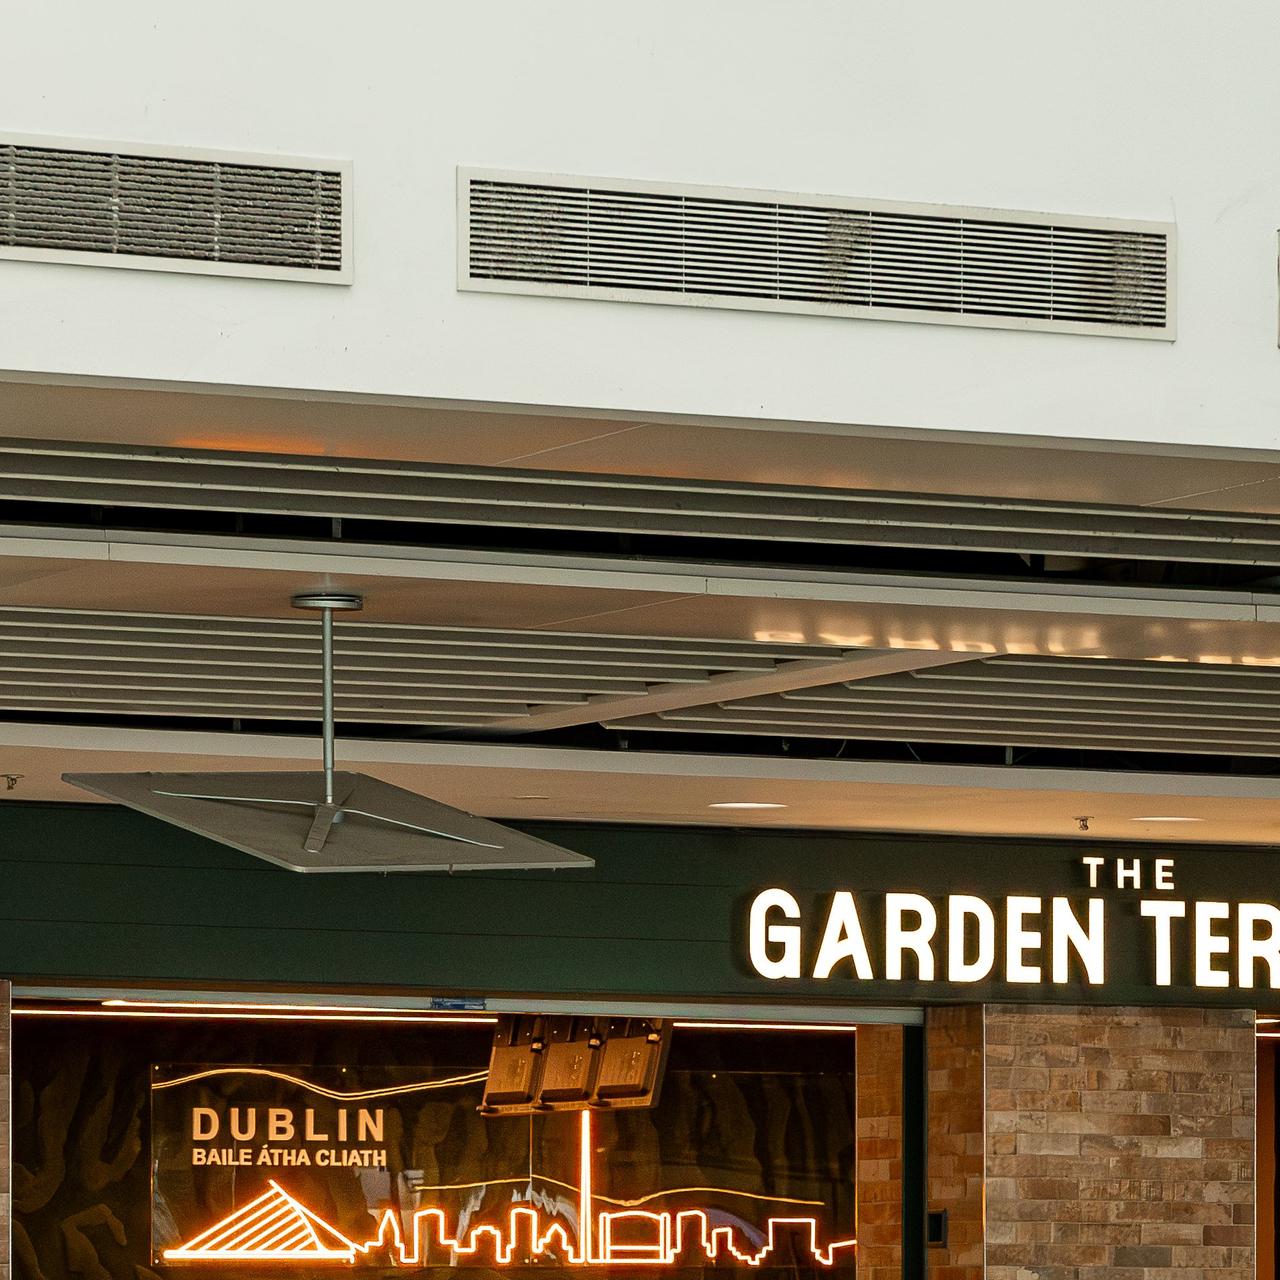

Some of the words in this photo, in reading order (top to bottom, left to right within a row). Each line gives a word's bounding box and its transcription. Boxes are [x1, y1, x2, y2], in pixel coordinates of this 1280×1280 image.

[1083, 857, 1175, 890] THE
[748, 887, 1105, 985] GARDEN
[192, 1107, 384, 1142] DUBLIN
[192, 1148, 253, 1166] BAILE
[257, 1144, 311, 1166] ÁTHA
[315, 1149, 387, 1167] CLIATH
